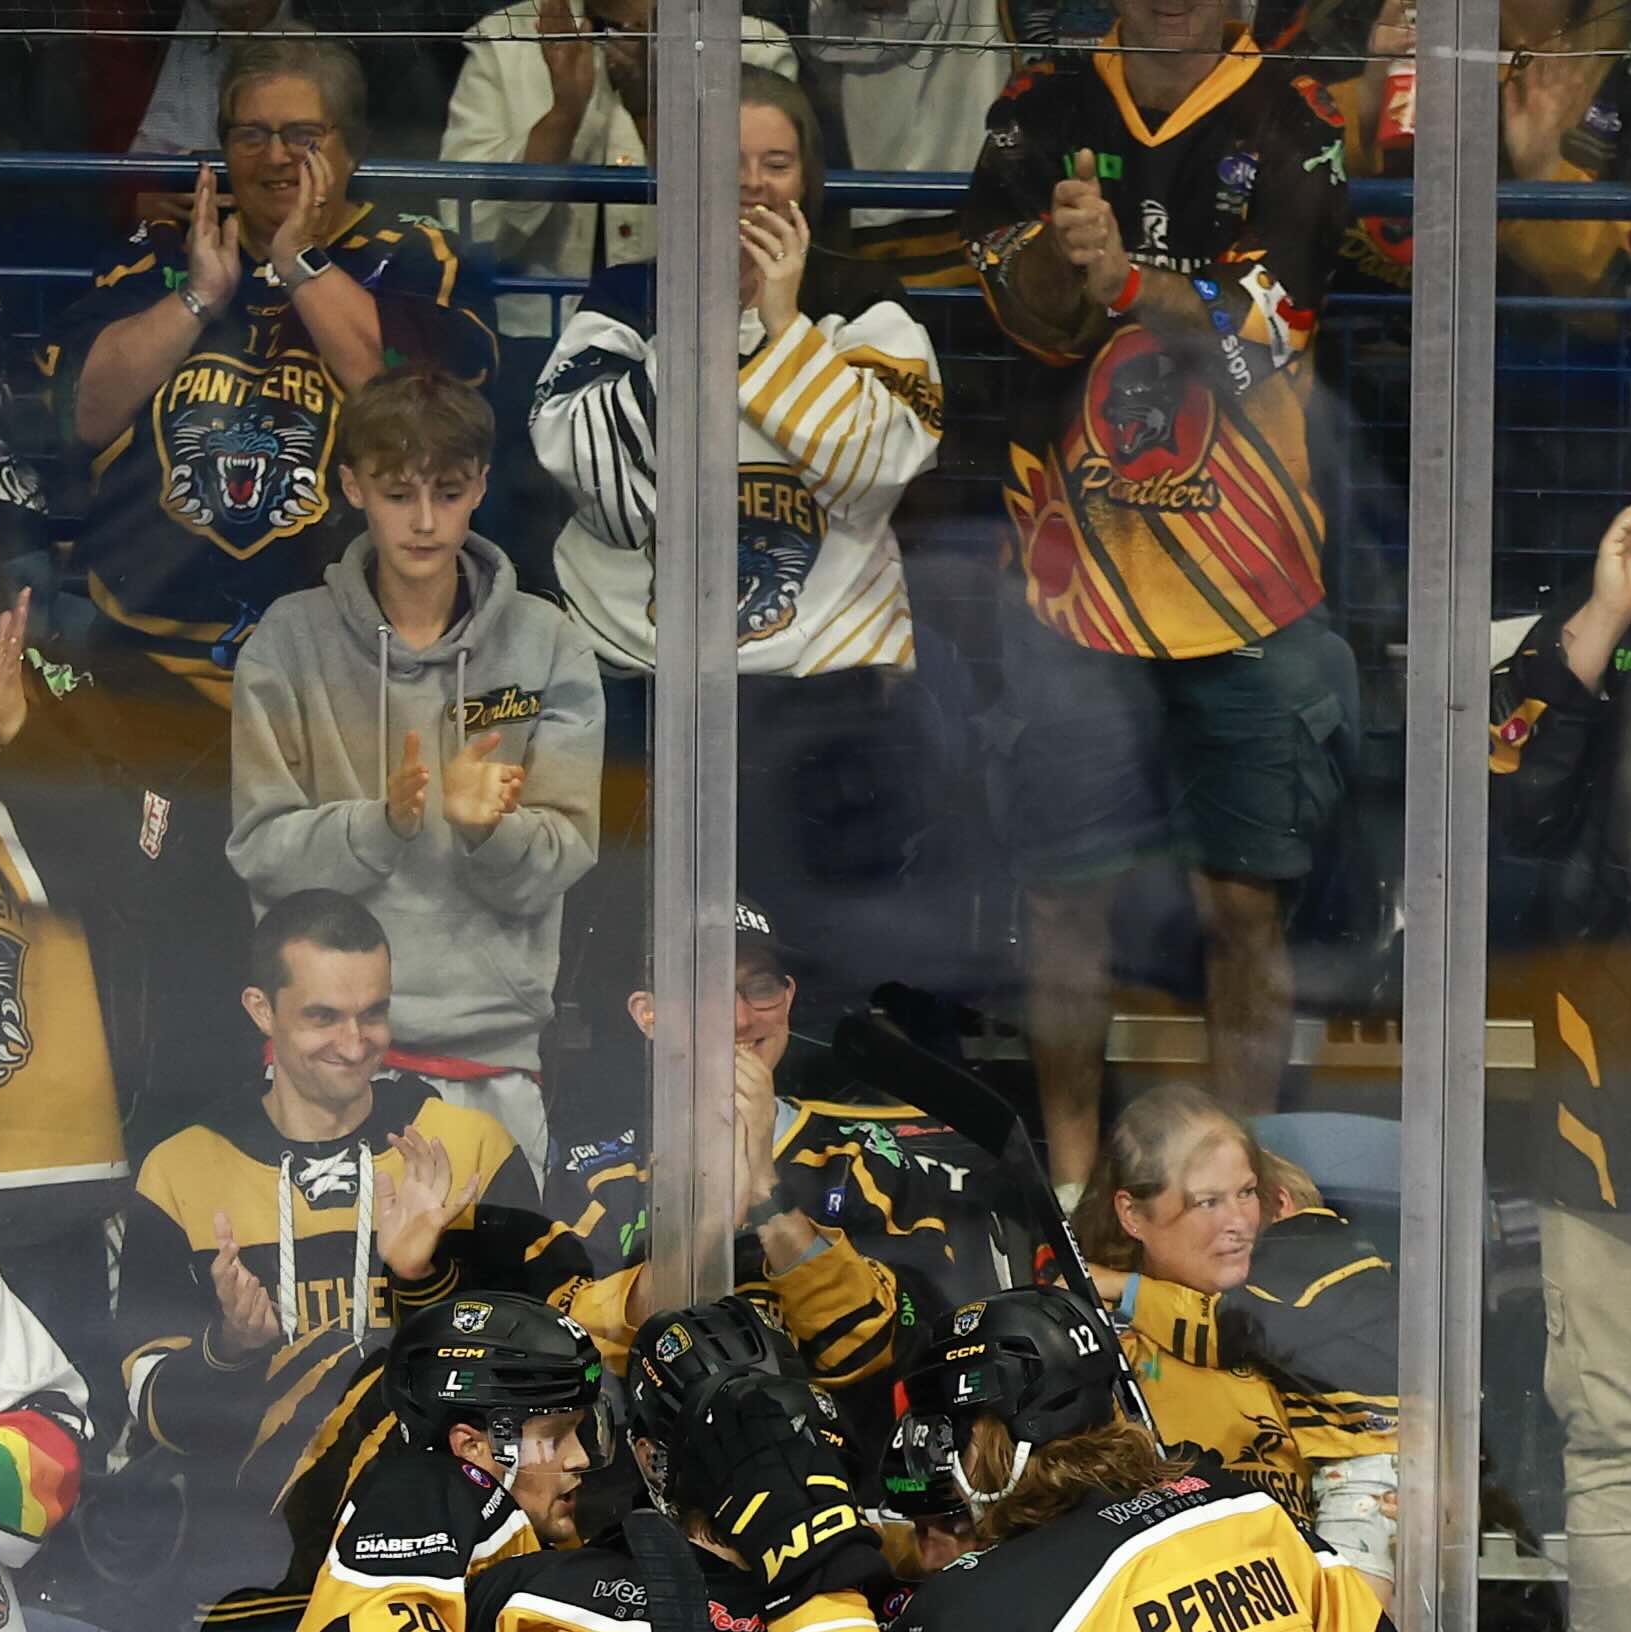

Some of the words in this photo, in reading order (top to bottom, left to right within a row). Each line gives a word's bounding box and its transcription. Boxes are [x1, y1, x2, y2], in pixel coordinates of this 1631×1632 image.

[167, 364, 325, 415] PANTERS
[1079, 454, 1223, 513] Panthers
[737, 481, 813, 535] HERS
[447, 687, 541, 725] Panther
[437, 1347, 486, 1359] CCM
[946, 1343, 986, 1361] CCM
[1068, 1324, 1101, 1357] 12
[641, 1356, 663, 1388] CCM
[761, 1503, 864, 1585] CM
